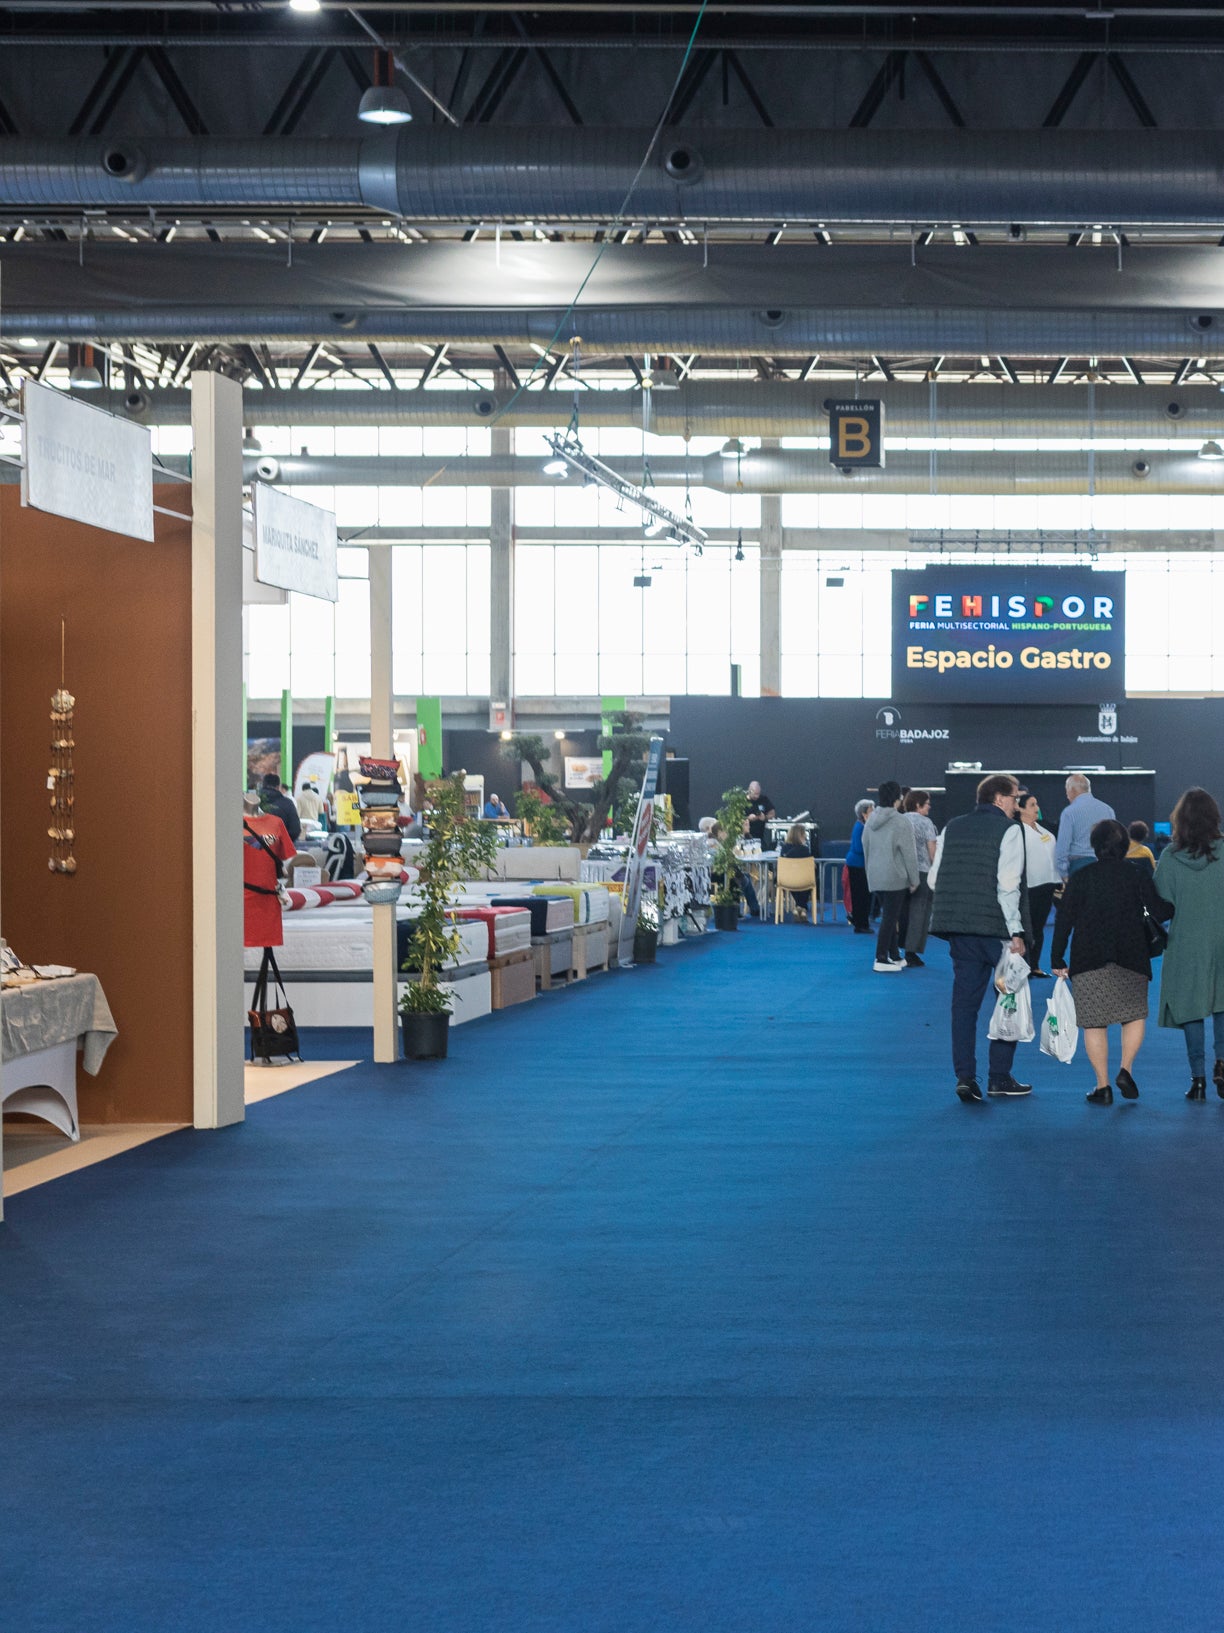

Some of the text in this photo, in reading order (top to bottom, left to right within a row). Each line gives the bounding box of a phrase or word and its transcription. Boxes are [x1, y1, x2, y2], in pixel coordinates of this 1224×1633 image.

[835, 403, 875, 411] PABELLÓN
[838, 416, 871, 458] B
[84, 455, 95, 476] DE
[97, 457, 116, 481] MAR
[262, 525, 294, 553] MARIQUITA
[909, 594, 1113, 619] FEHISPOR
[909, 622, 1112, 631] FERIA MULTISECTORIAL HISPANO-PORTUGUESA
[906, 645, 1112, 673] Espacio Gastro
